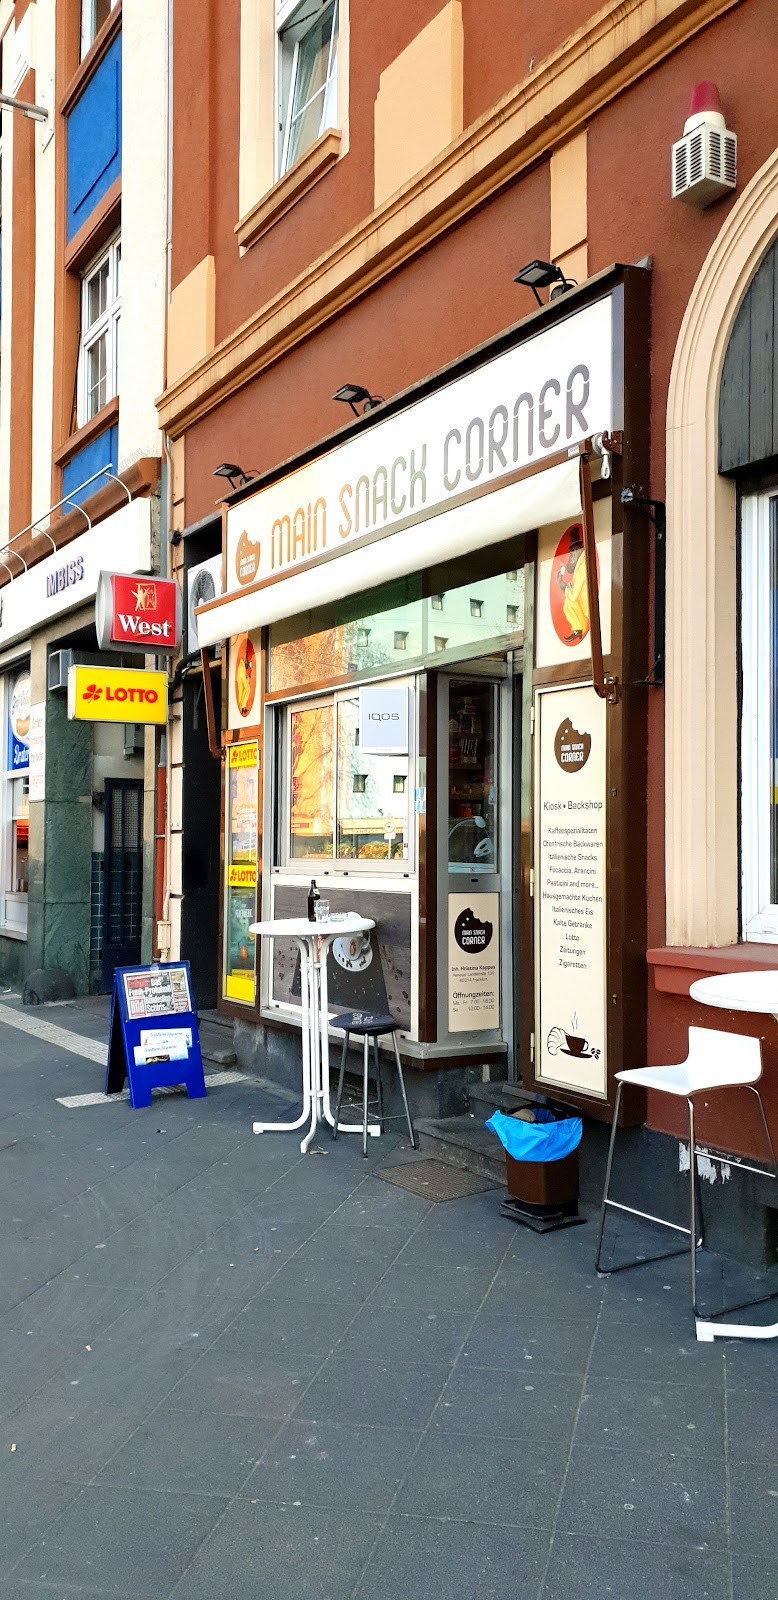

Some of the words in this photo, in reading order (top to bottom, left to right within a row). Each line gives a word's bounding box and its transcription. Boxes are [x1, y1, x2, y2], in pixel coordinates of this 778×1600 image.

[270, 496, 327, 571] MAIN
[338, 443, 427, 540] SNACK
[443, 364, 590, 492] CORNER
[46, 556, 84, 598] IMBISS
[118, 614, 172, 638] West
[106, 686, 158, 704] LOTTO
[368, 712, 400, 722] IQOS
[239, 748, 257, 760] LOTTO
[560, 751, 584, 763] CORNER
[543, 801, 562, 810] Kiosk
[568, 800, 602, 811] Backshop
[548, 827, 597, 835] Kaffeespezialitäten
[550, 866, 573, 874] Focaccia,
[238, 870, 256, 882] LOTTO
[542, 892, 580, 901] Hausgemachte
[582, 894, 603, 902] Kuchen
[552, 905, 584, 915] Italienisches
[585, 908, 594, 916] Eis
[568, 920, 592, 929] Getränke
[462, 936, 485, 945] CORNER
[560, 945, 586, 956] Zeitungen
[559, 959, 587, 969] Zigaretten
[150, 978, 162, 987] Das
